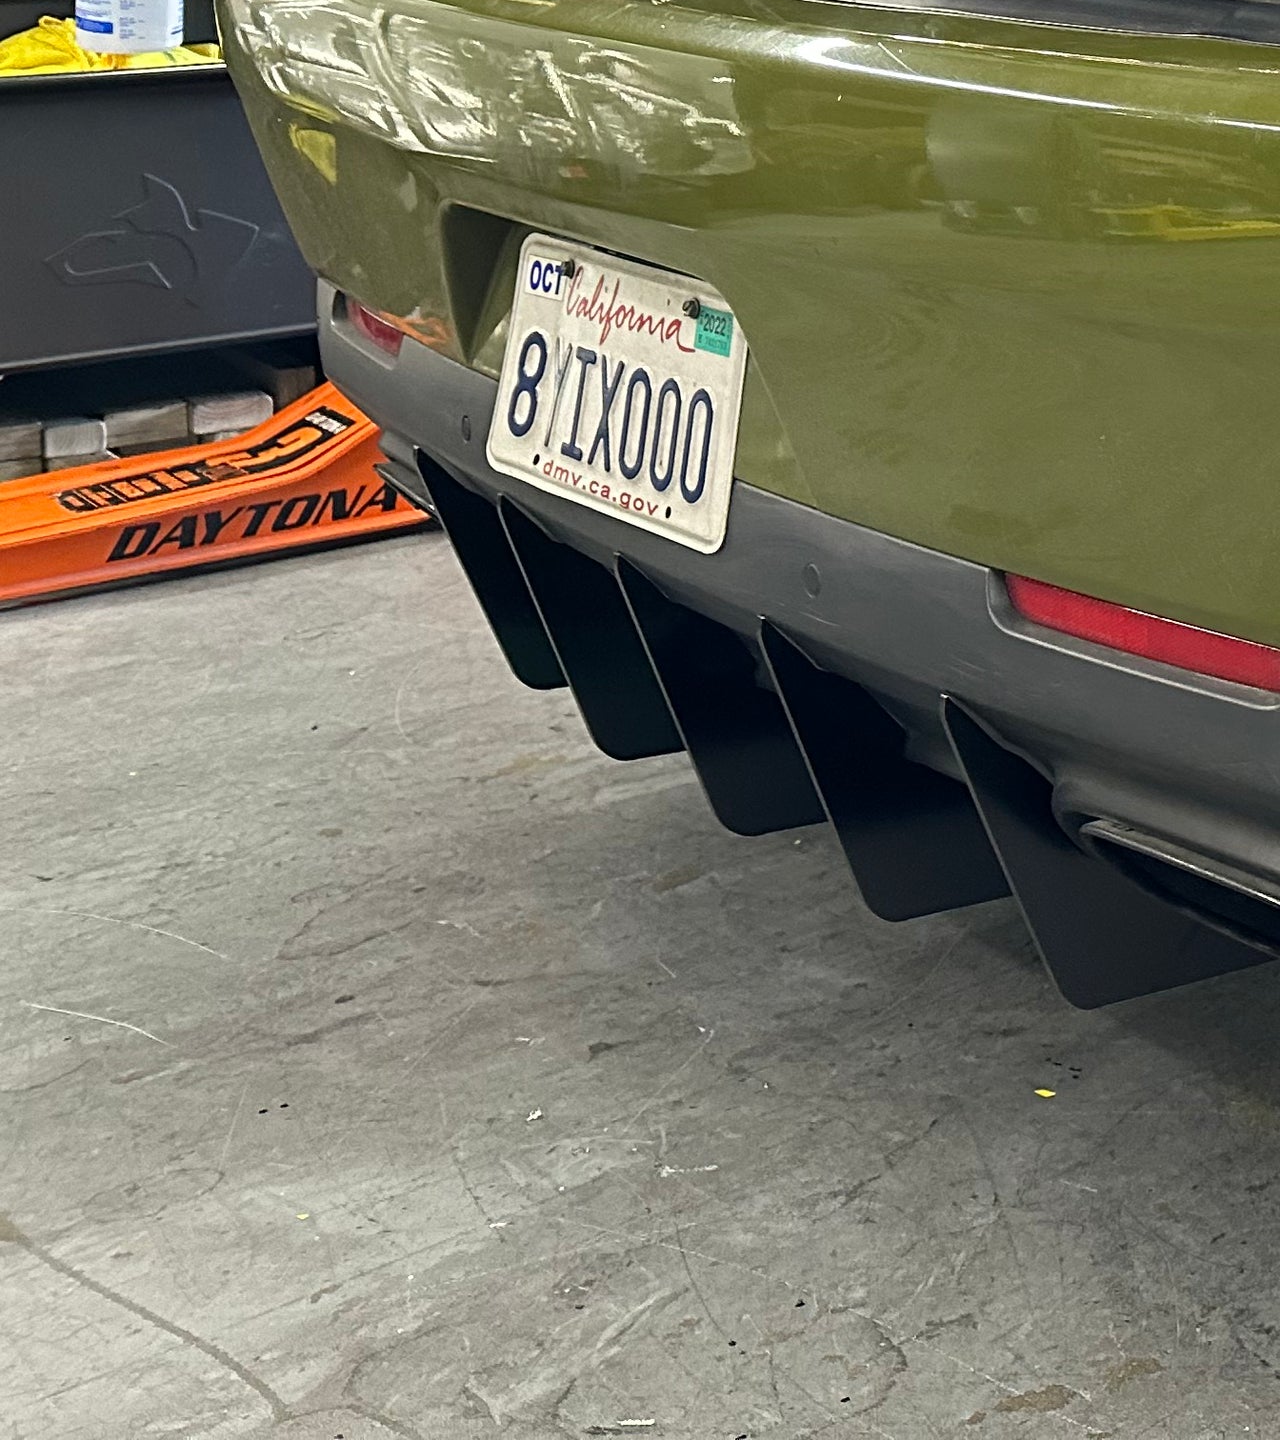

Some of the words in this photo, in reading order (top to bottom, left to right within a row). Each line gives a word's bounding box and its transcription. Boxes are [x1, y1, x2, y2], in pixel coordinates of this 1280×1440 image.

[530, 260, 563, 295] OCT
[566, 265, 696, 353] California
[703, 313, 727, 336] 2022
[106, 484, 401, 562] DAYTONA
[543, 460, 659, 516] dmv.ca.gov
